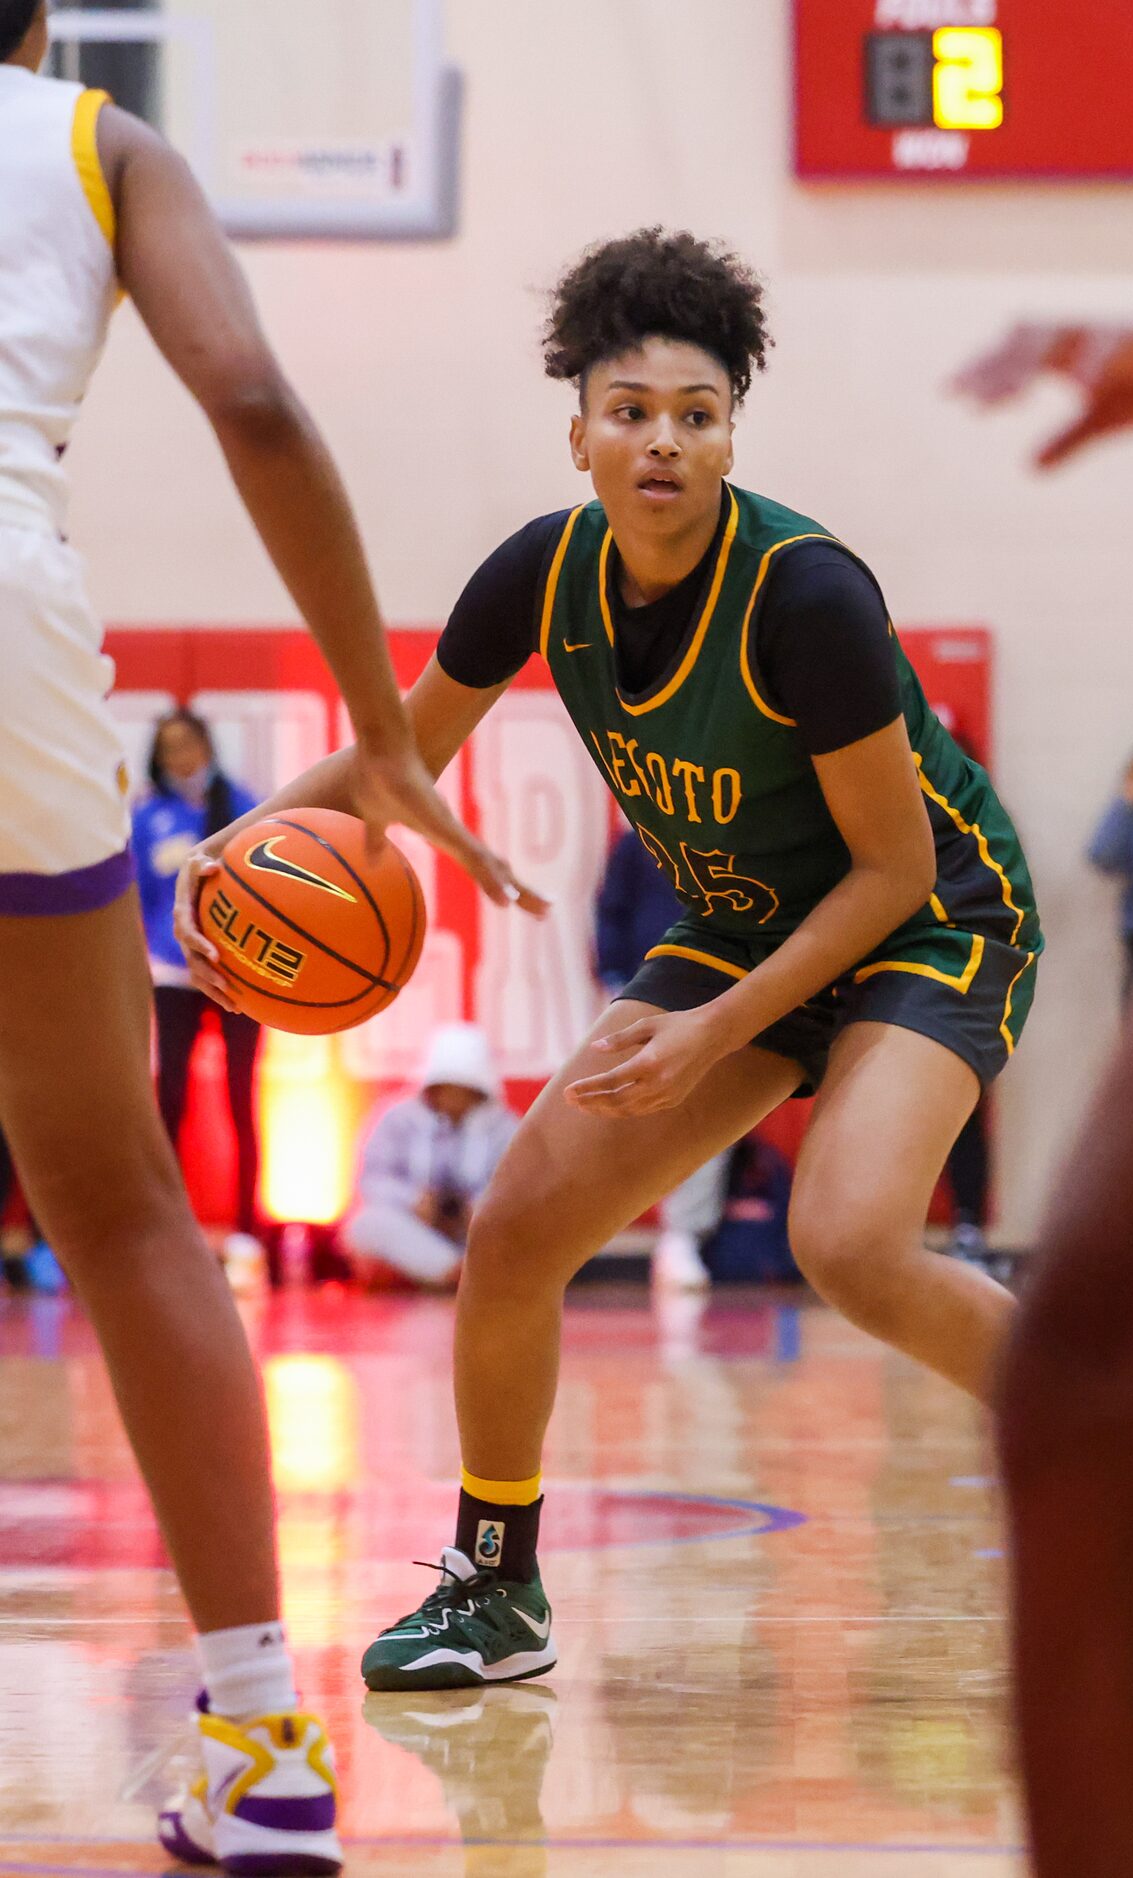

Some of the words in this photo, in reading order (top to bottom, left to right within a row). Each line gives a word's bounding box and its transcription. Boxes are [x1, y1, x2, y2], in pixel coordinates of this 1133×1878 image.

[933, 26, 1003, 129] 2
[590, 730, 743, 825] ESOTO
[208, 888, 305, 981] ELITE
